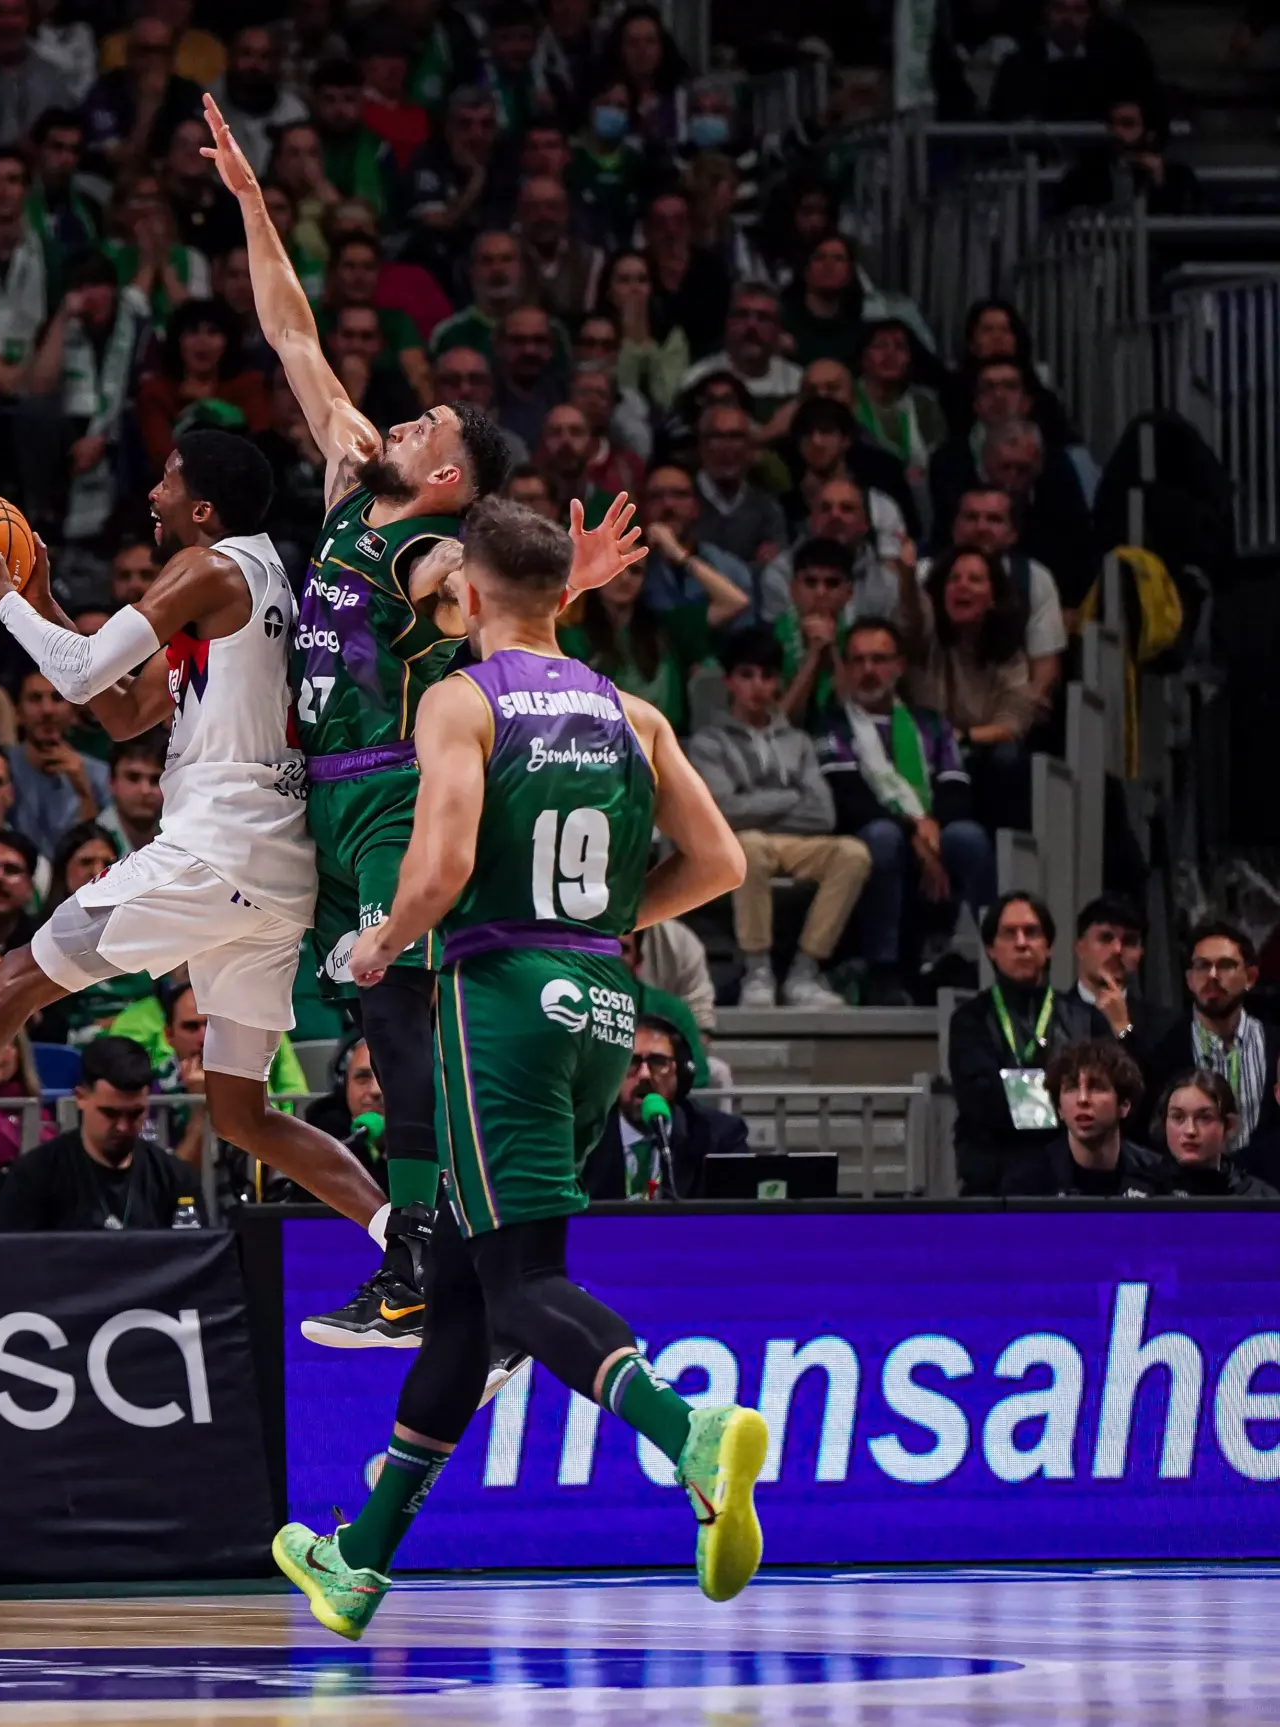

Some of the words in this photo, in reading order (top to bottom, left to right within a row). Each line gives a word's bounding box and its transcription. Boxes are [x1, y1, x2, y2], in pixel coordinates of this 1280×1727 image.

[304, 575, 360, 610] nicaja
[297, 676, 336, 724] 27
[532, 807, 611, 920] 19
[589, 986, 635, 1015] COSTA
[592, 1006, 615, 1027] DEL
[616, 1013, 635, 1033] SOL
